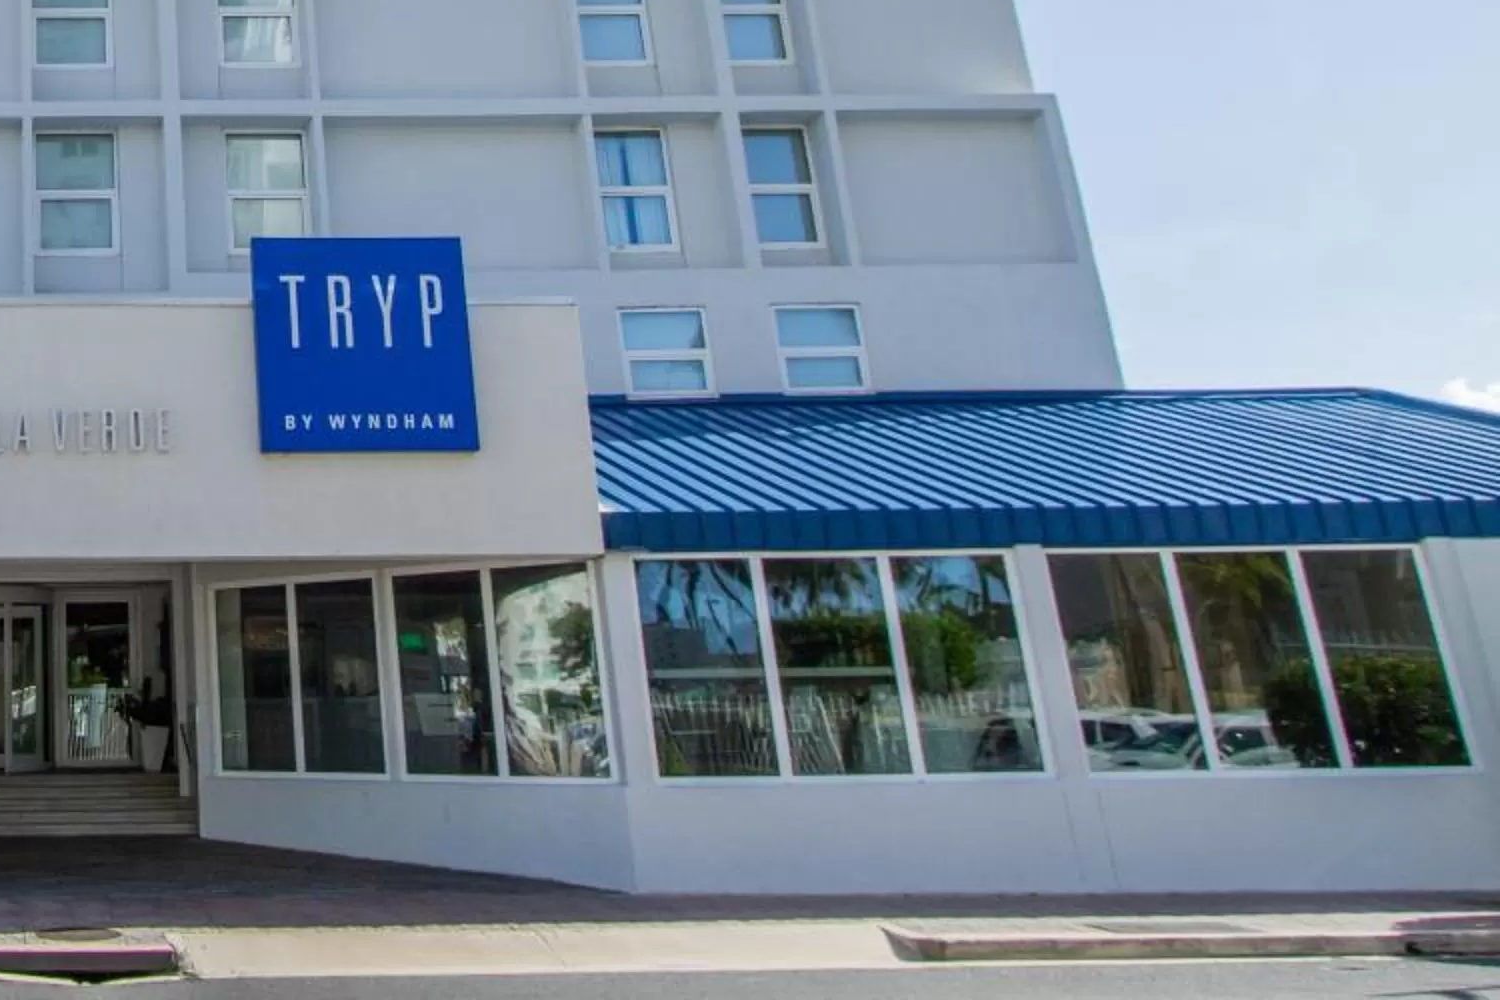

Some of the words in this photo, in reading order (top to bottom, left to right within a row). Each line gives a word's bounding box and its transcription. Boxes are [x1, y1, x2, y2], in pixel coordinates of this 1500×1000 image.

[278, 274, 443, 348] TRYP
[51, 407, 171, 455] VERDE
[284, 414, 314, 431] BY
[328, 413, 454, 430] WYNDHAM
